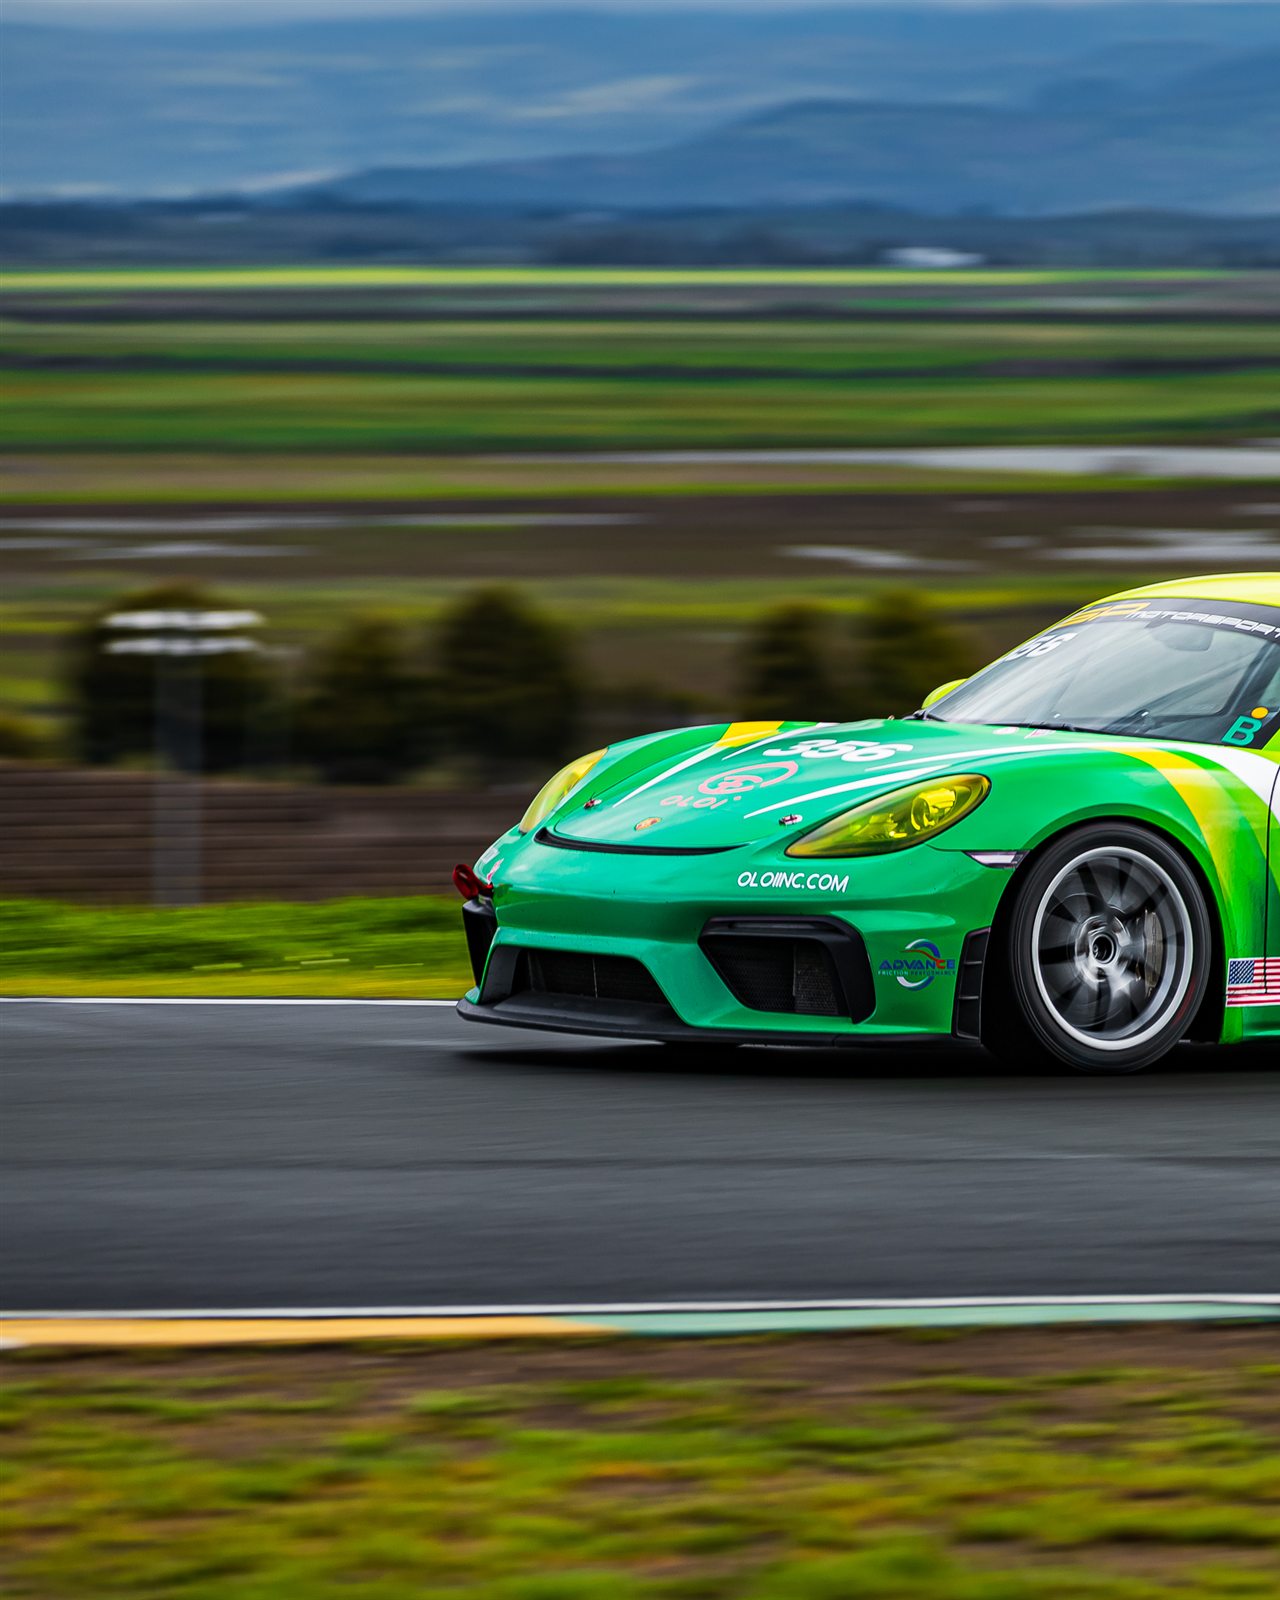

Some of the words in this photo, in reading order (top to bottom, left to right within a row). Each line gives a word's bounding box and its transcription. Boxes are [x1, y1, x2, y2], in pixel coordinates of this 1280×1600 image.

[1221, 714, 1263, 747] B
[762, 738, 914, 762] 356
[737, 871, 850, 893] OLOIINC.COM
[879, 959, 956, 970] ADVANCE
